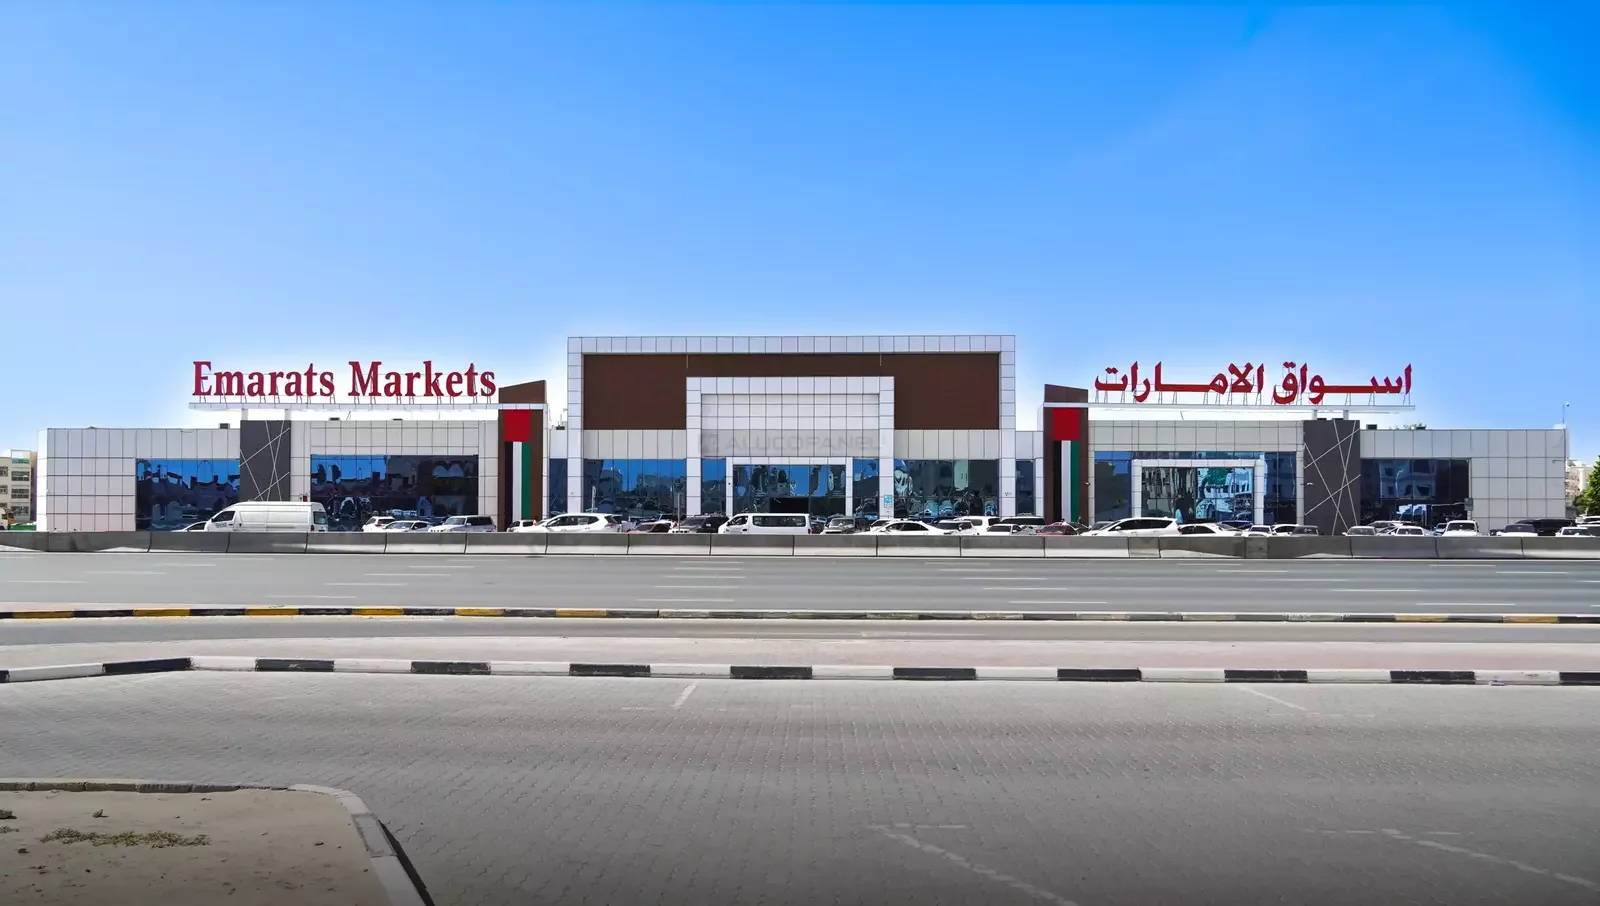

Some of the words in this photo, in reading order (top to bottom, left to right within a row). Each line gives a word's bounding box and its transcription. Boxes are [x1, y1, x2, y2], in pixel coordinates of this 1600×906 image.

[193, 361, 335, 397] Emarats
[348, 361, 496, 397] Markets
[1094, 361, 1265, 403] الامارات
[1273, 361, 1412, 405] اسواق
